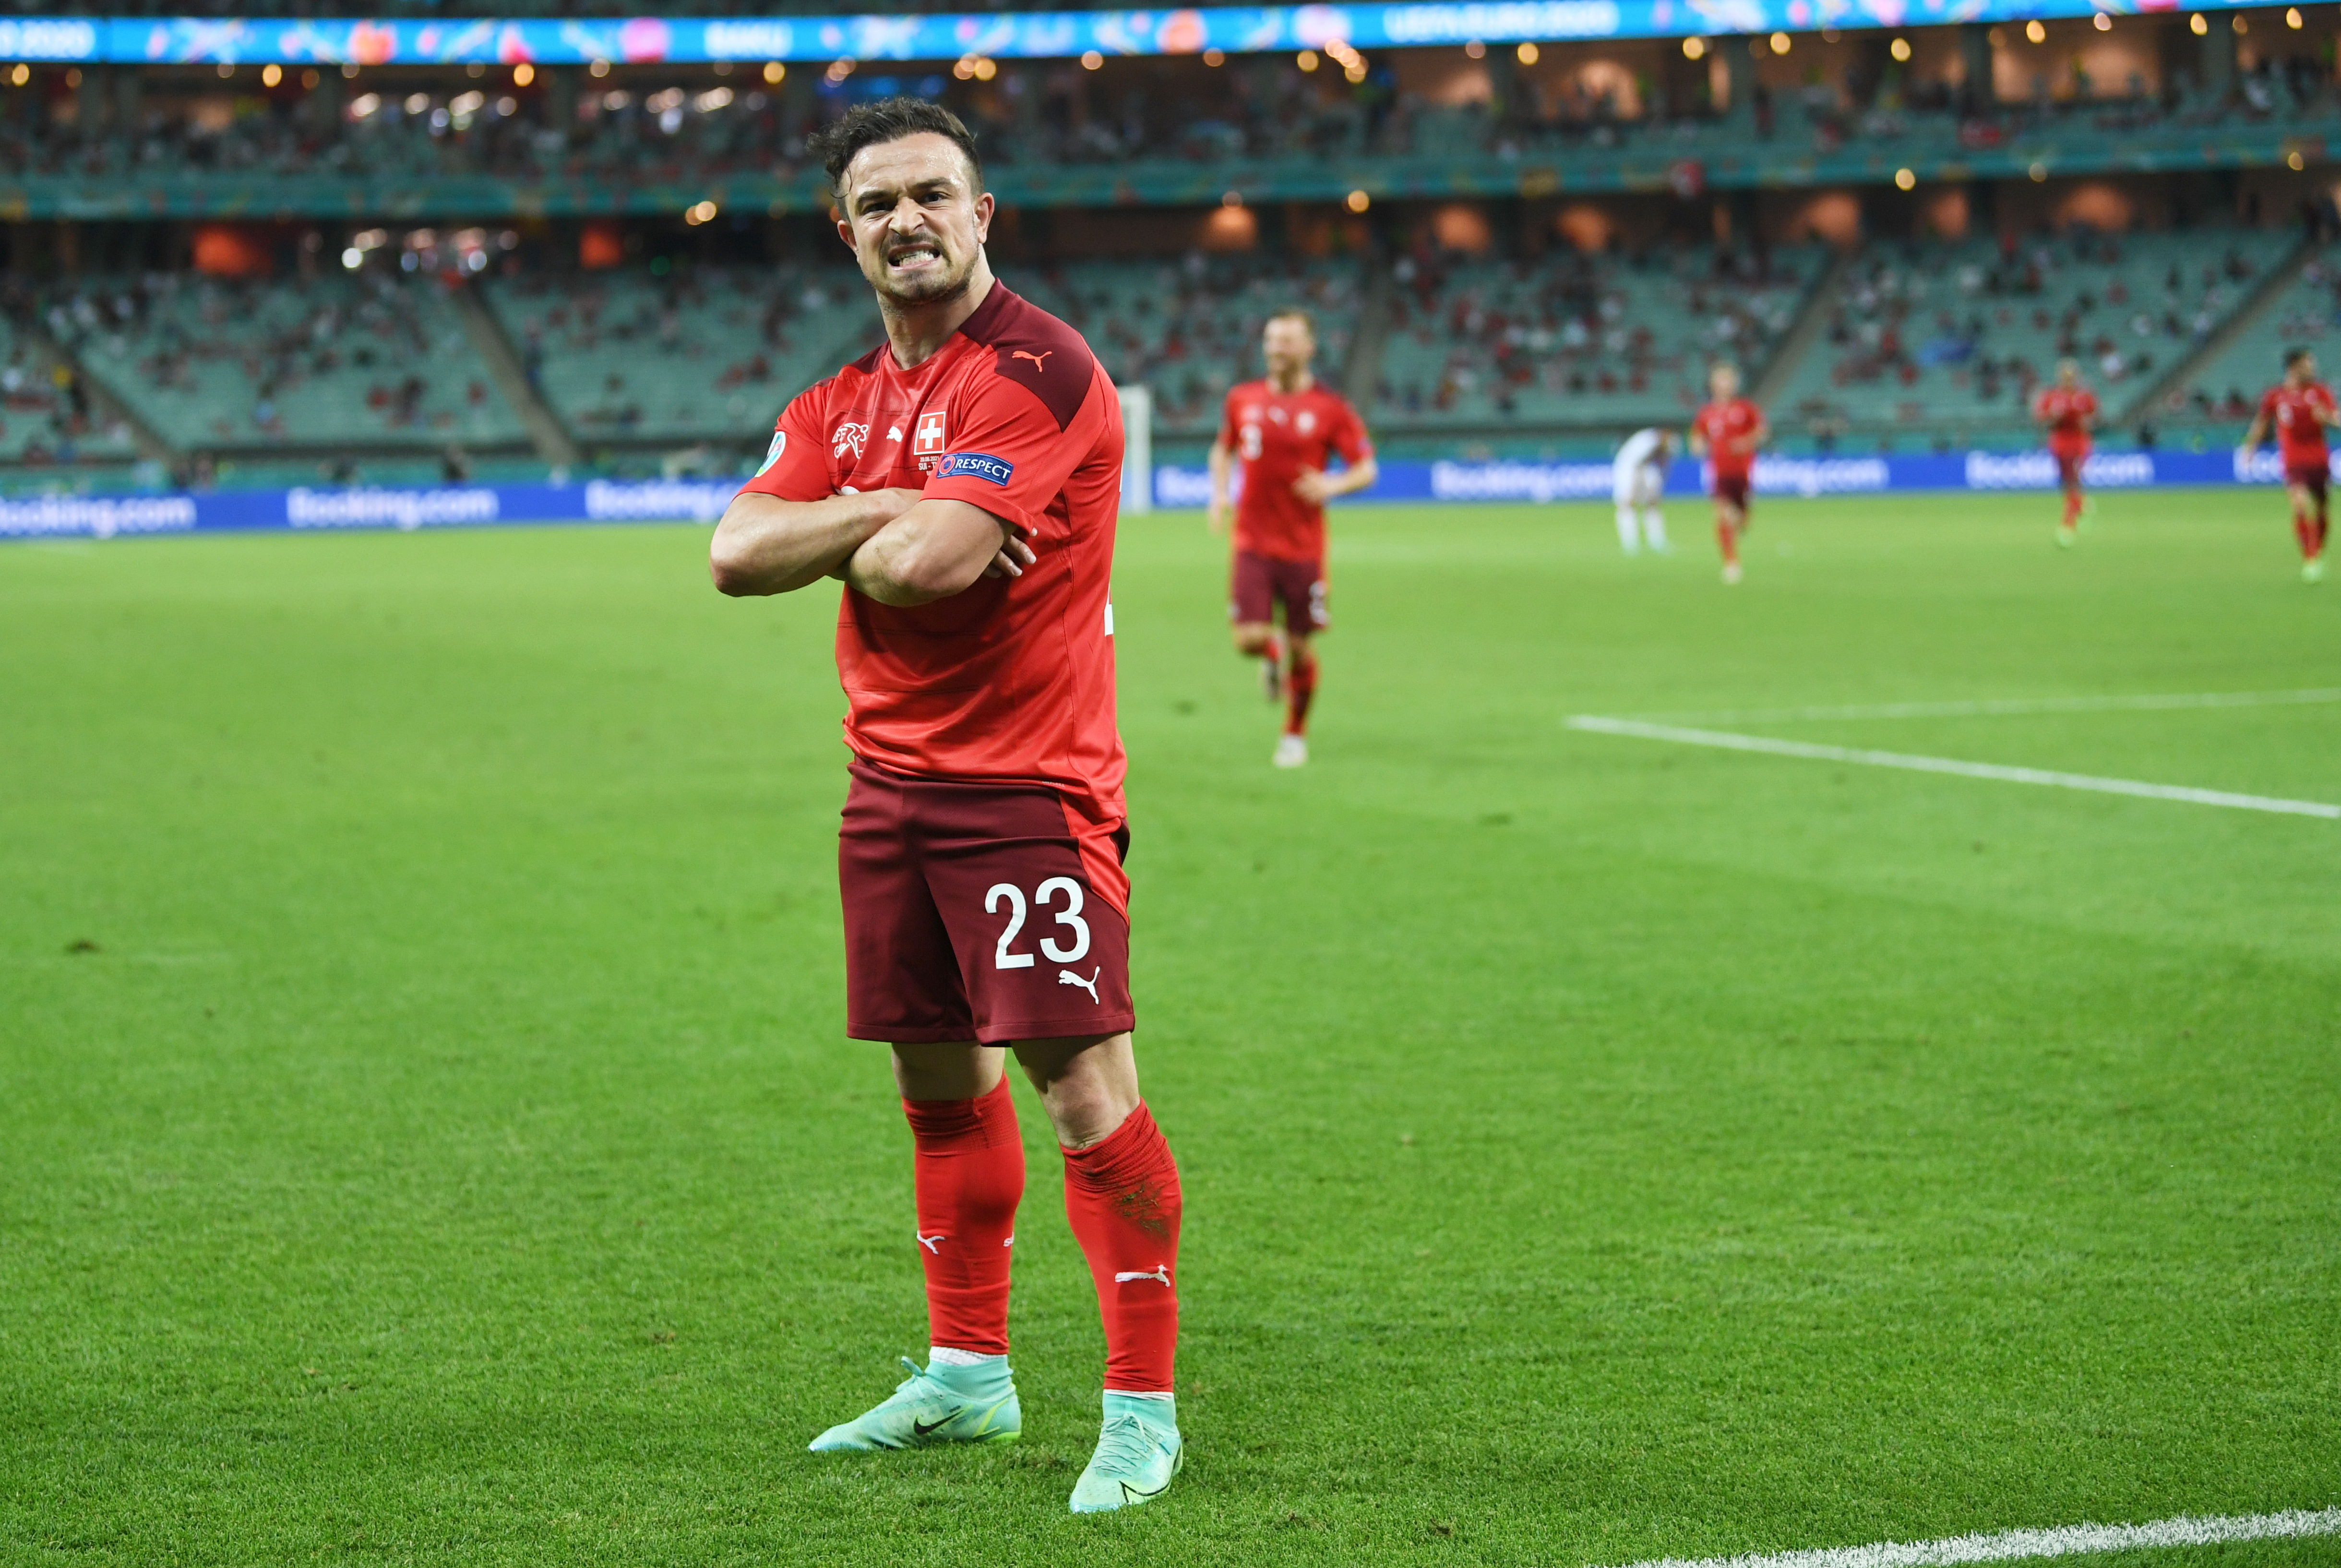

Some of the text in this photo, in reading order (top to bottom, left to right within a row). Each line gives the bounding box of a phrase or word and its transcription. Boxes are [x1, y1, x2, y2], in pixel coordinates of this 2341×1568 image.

[955, 458, 1011, 479] RESPECT
[0, 496, 196, 537] ooking.com
[985, 876, 1090, 970] 23
